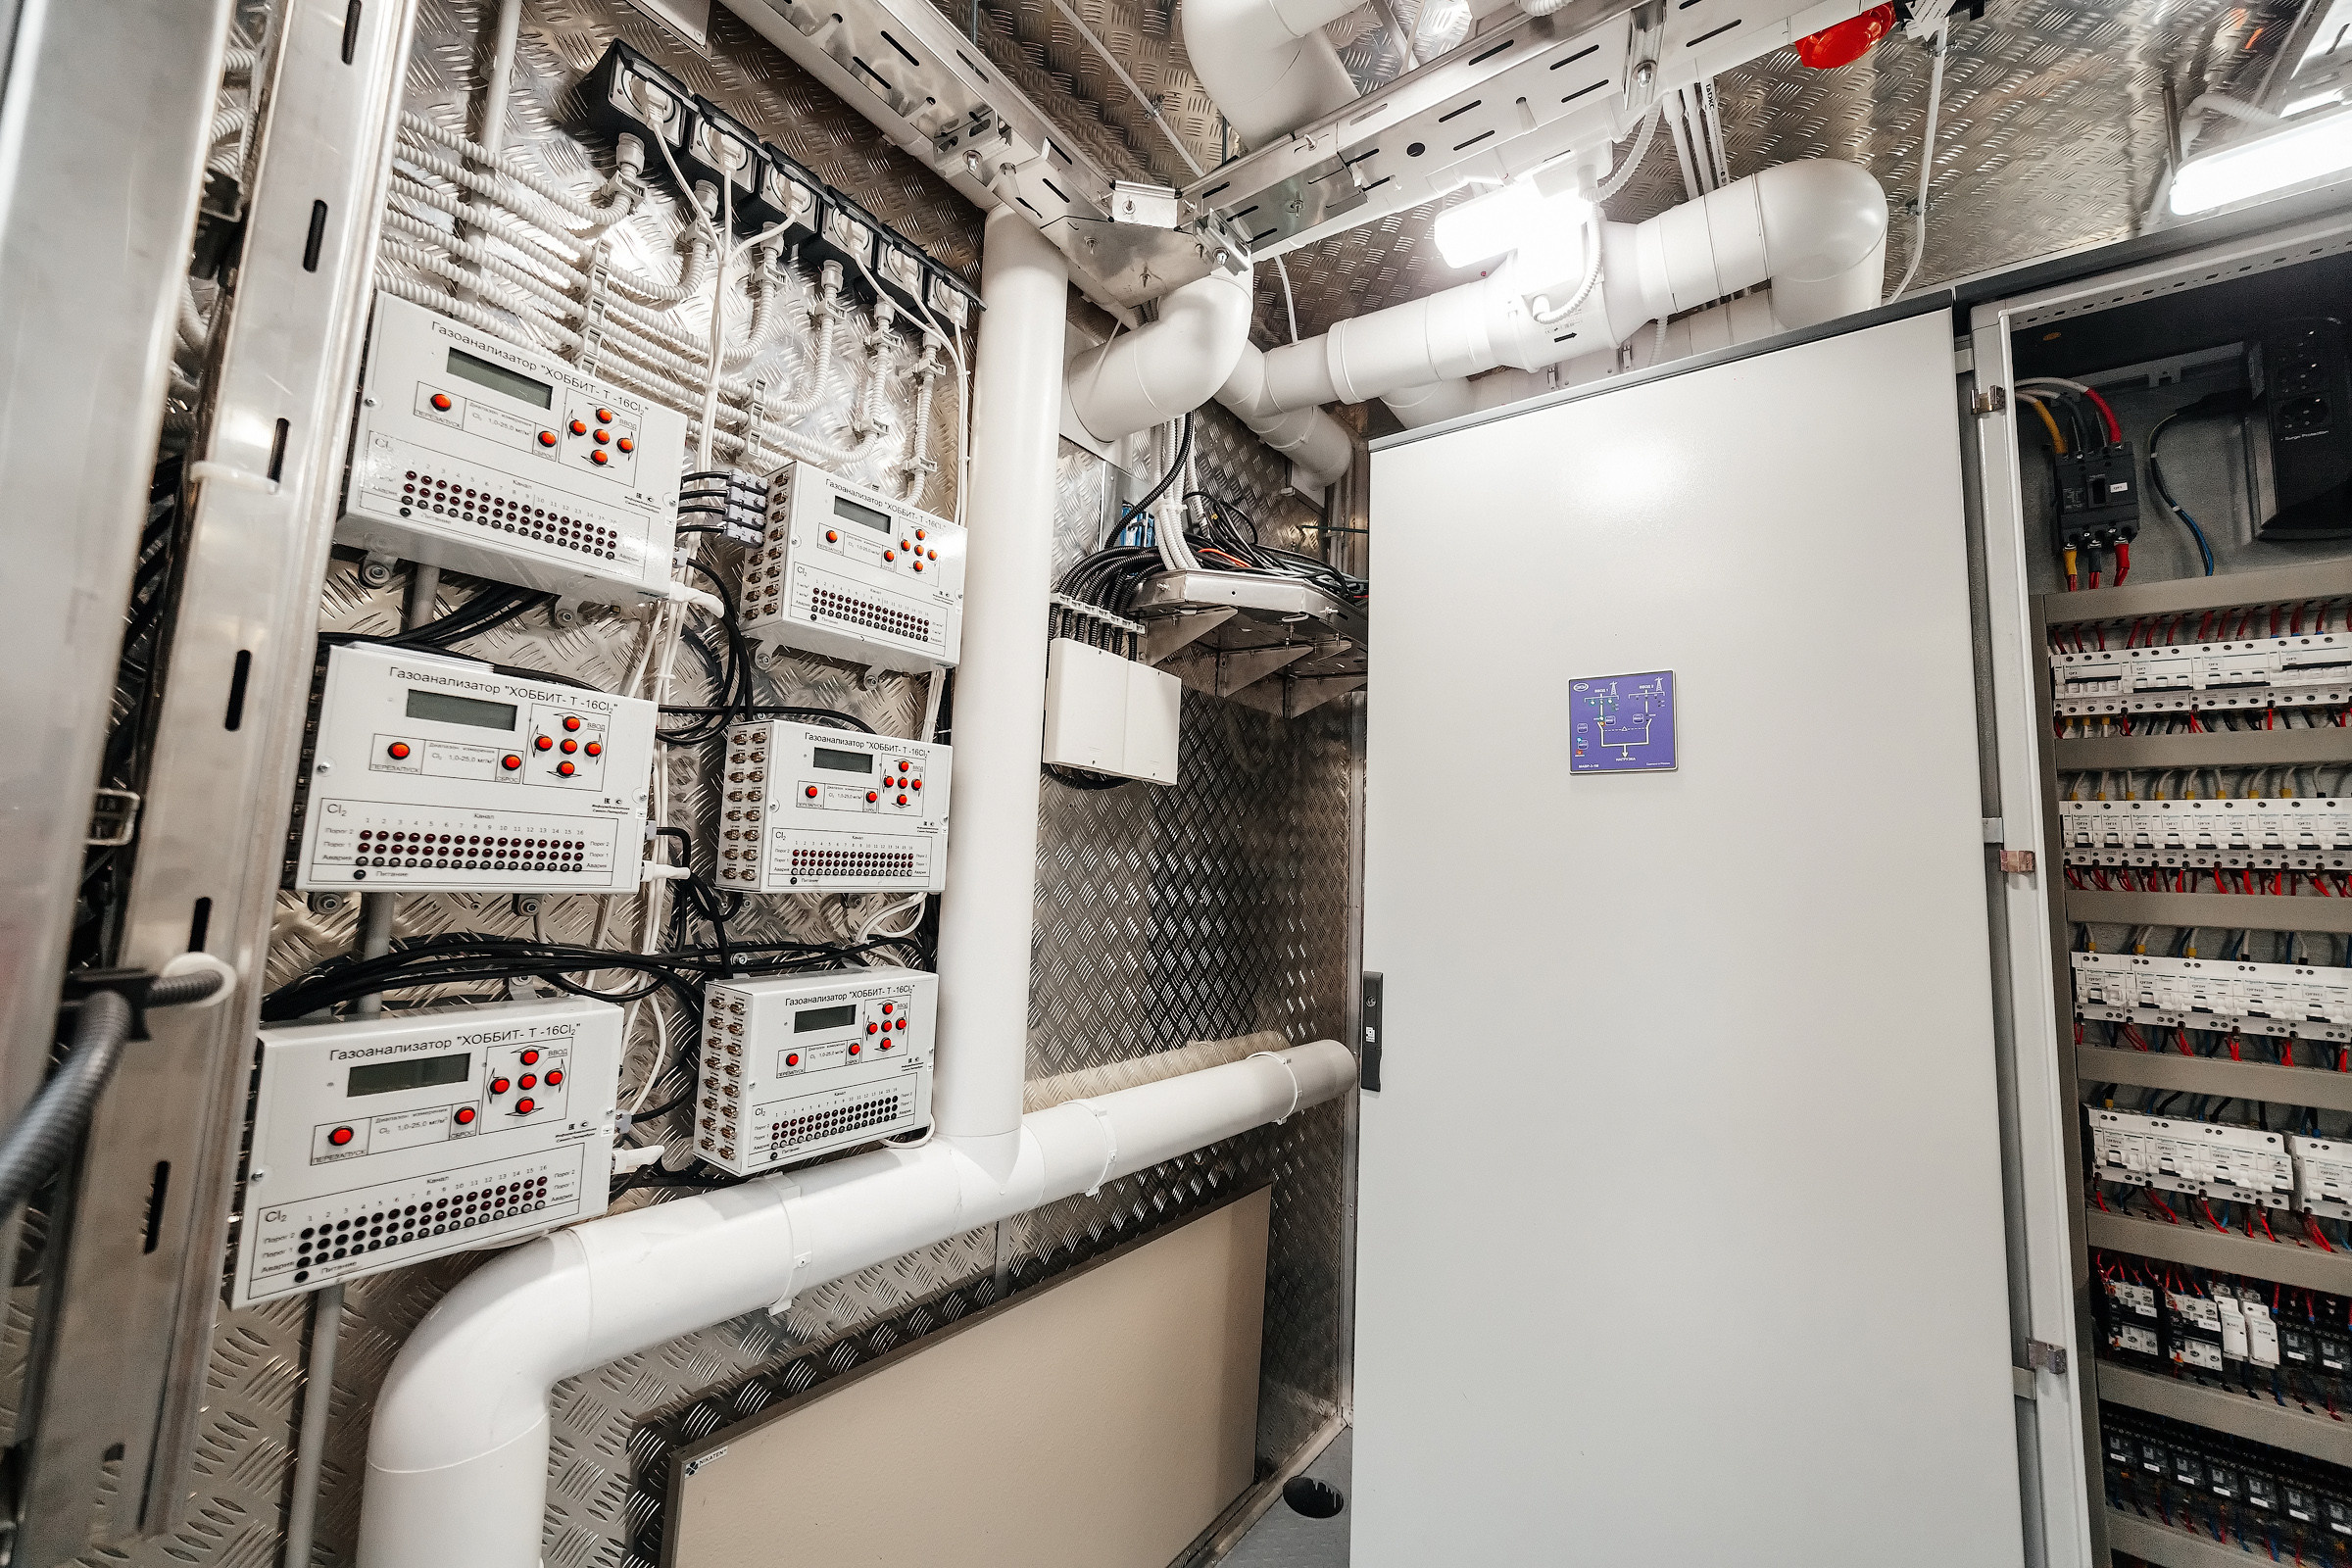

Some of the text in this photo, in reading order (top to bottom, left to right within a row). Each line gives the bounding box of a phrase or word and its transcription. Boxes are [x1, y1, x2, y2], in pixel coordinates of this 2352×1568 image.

[431, 321, 537, 373] Газоанализатор
[540, 364, 600, 396] "ХОББИТ-
[825, 478, 883, 509] Газоанализатор
[388, 666, 500, 696] Газоанализатор
[504, 685, 566, 704] "ХОББИТ-
[804, 732, 865, 749] Газоанализатор
[866, 741, 901, 753] "ХОББИТ-
[785, 991, 847, 1008] Газоанализатор
[849, 987, 885, 999] "ХОББИТ-
[329, 1037, 452, 1064] Газоанализатор
[456, 1028, 525, 1046] "ХОББИТ-
[426, 1175, 448, 1185] Канал
[320, 1259, 357, 1274] Питание
